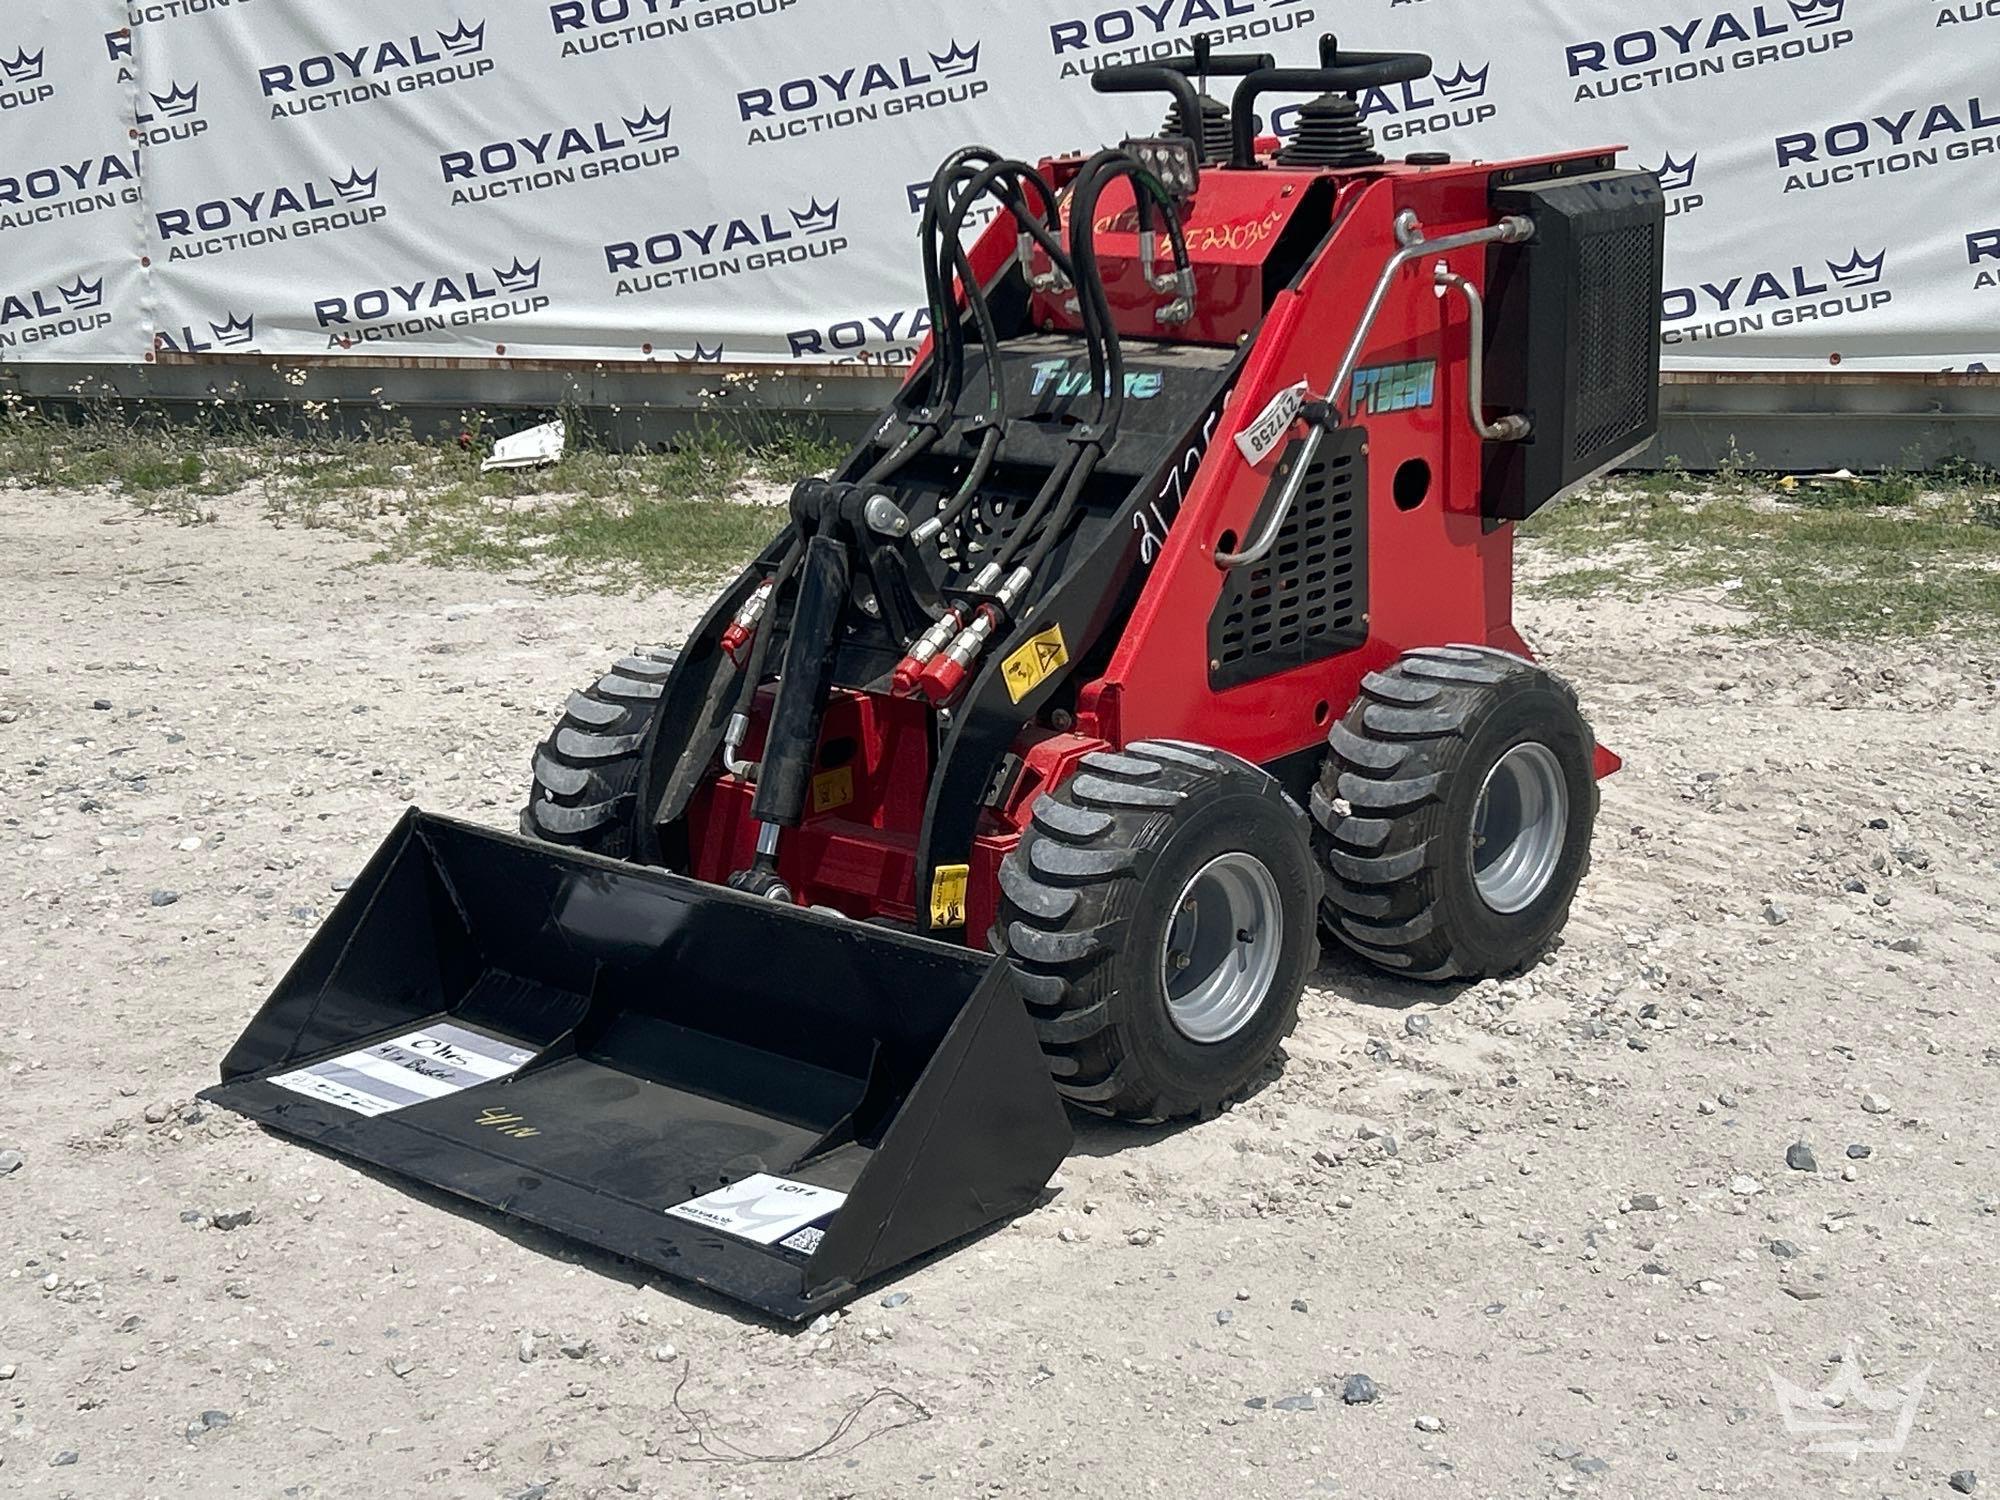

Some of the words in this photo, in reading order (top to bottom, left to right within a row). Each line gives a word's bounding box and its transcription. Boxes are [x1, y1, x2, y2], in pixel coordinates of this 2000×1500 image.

[561, 16, 688, 58] AUCTION
[1050, 0, 1255, 54] ROYAL
[1565, 6, 1788, 77] ROYAL
[258, 36, 441, 97] ROYAL
[271, 81, 391, 120] AUCTION
[397, 59, 494, 92] GROUP
[737, 57, 931, 122] ROYAL
[1574, 56, 1724, 102] AUCTION
[1732, 30, 1853, 69] GROUP
[748, 104, 877, 145] AUCTION
[884, 81, 988, 116] GROUP
[1382, 104, 1496, 141] GROUP
[1775, 98, 2000, 168] ROYAL
[440, 122, 625, 183] ROYAL
[451, 167, 575, 206] AUCTION
[581, 146, 679, 179] GROUP
[1783, 148, 1938, 193] AUCTION
[0, 192, 116, 230] AUCTION
[155, 183, 335, 240] ROYAL
[169, 225, 287, 262] AUCTION
[292, 206, 386, 237] GROUP
[604, 211, 792, 273] ROYAL
[615, 258, 740, 296] AUCTION
[746, 236, 848, 270] GROUP
[22, 313, 112, 343] GROUP
[314, 273, 496, 328] ROYAL
[452, 296, 549, 327] GROUP
[1772, 290, 1891, 326] GROUP
[1250, 396, 1298, 451] 217258
[776, 1183, 805, 1195] LOT
